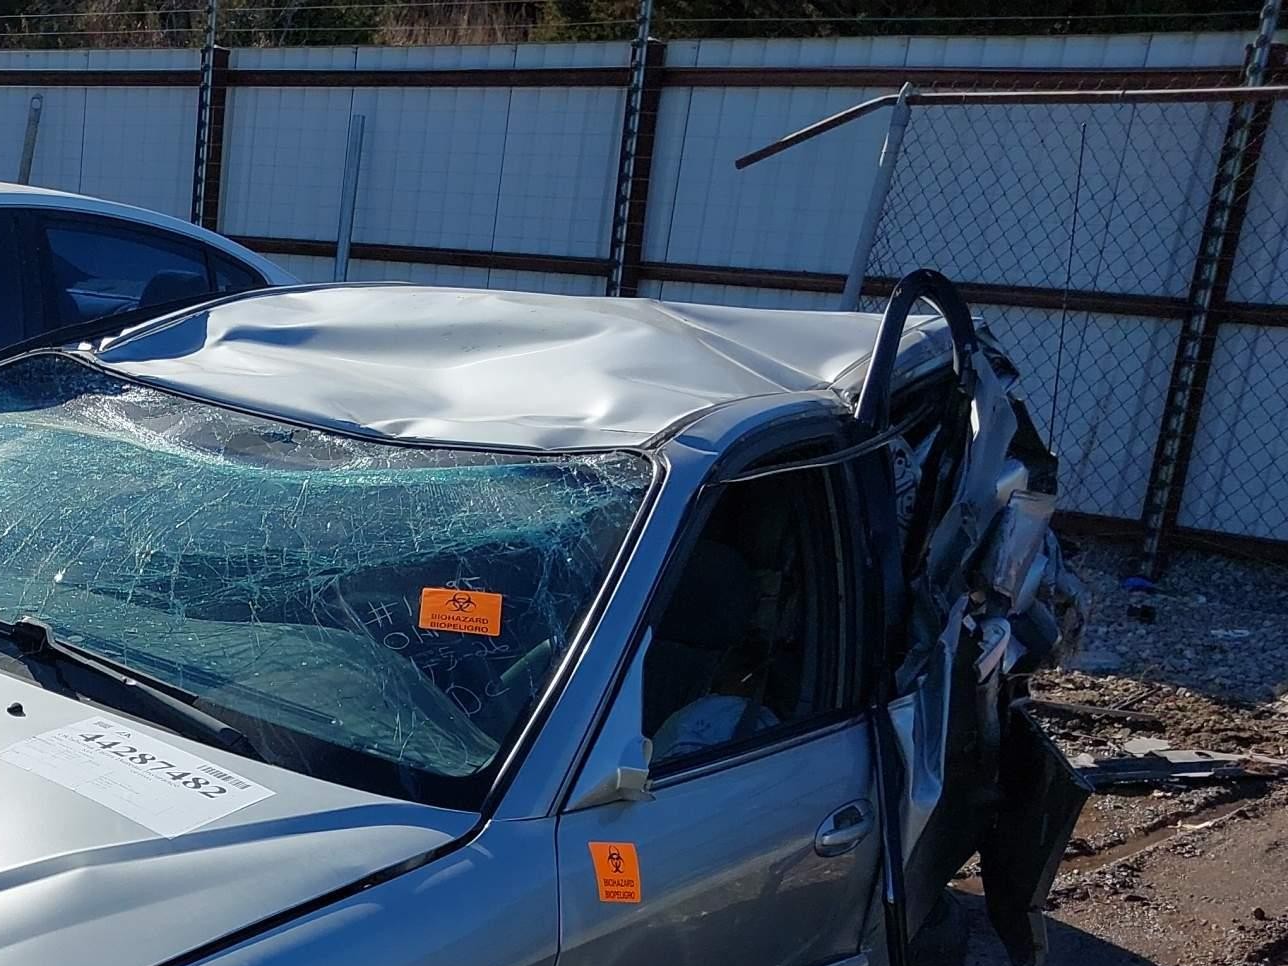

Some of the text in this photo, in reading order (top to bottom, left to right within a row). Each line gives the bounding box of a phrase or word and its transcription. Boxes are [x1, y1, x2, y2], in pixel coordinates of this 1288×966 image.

[431, 613, 489, 625] BIOHAZARD
[429, 621, 489, 633] BIOPELIGRO
[78, 732, 227, 799] 44287482
[603, 878, 635, 888] BIOHAZARD
